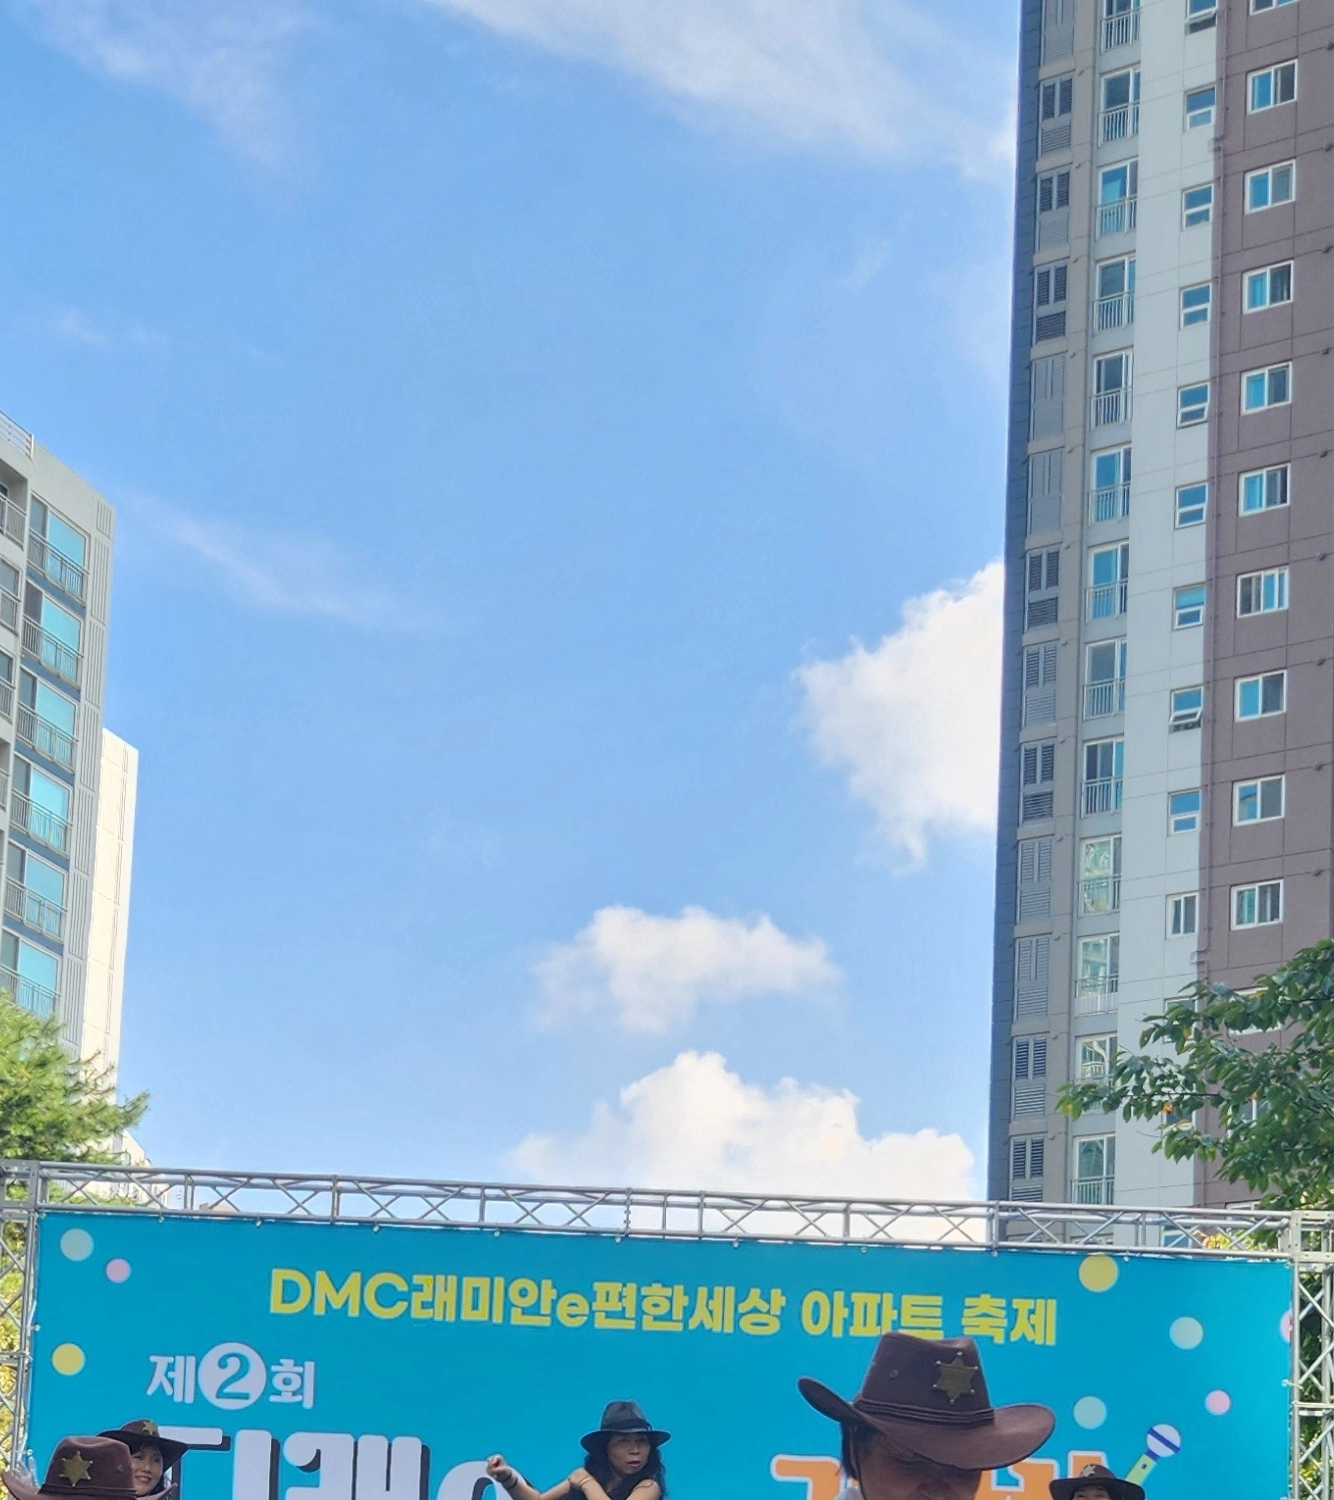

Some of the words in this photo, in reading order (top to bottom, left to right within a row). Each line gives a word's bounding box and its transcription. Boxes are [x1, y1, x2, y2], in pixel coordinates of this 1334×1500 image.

[269, 1267, 786, 1335] DMC래미안e편한세상
[802, 1290, 945, 1340] 아파트
[961, 1293, 1058, 1346] 축제
